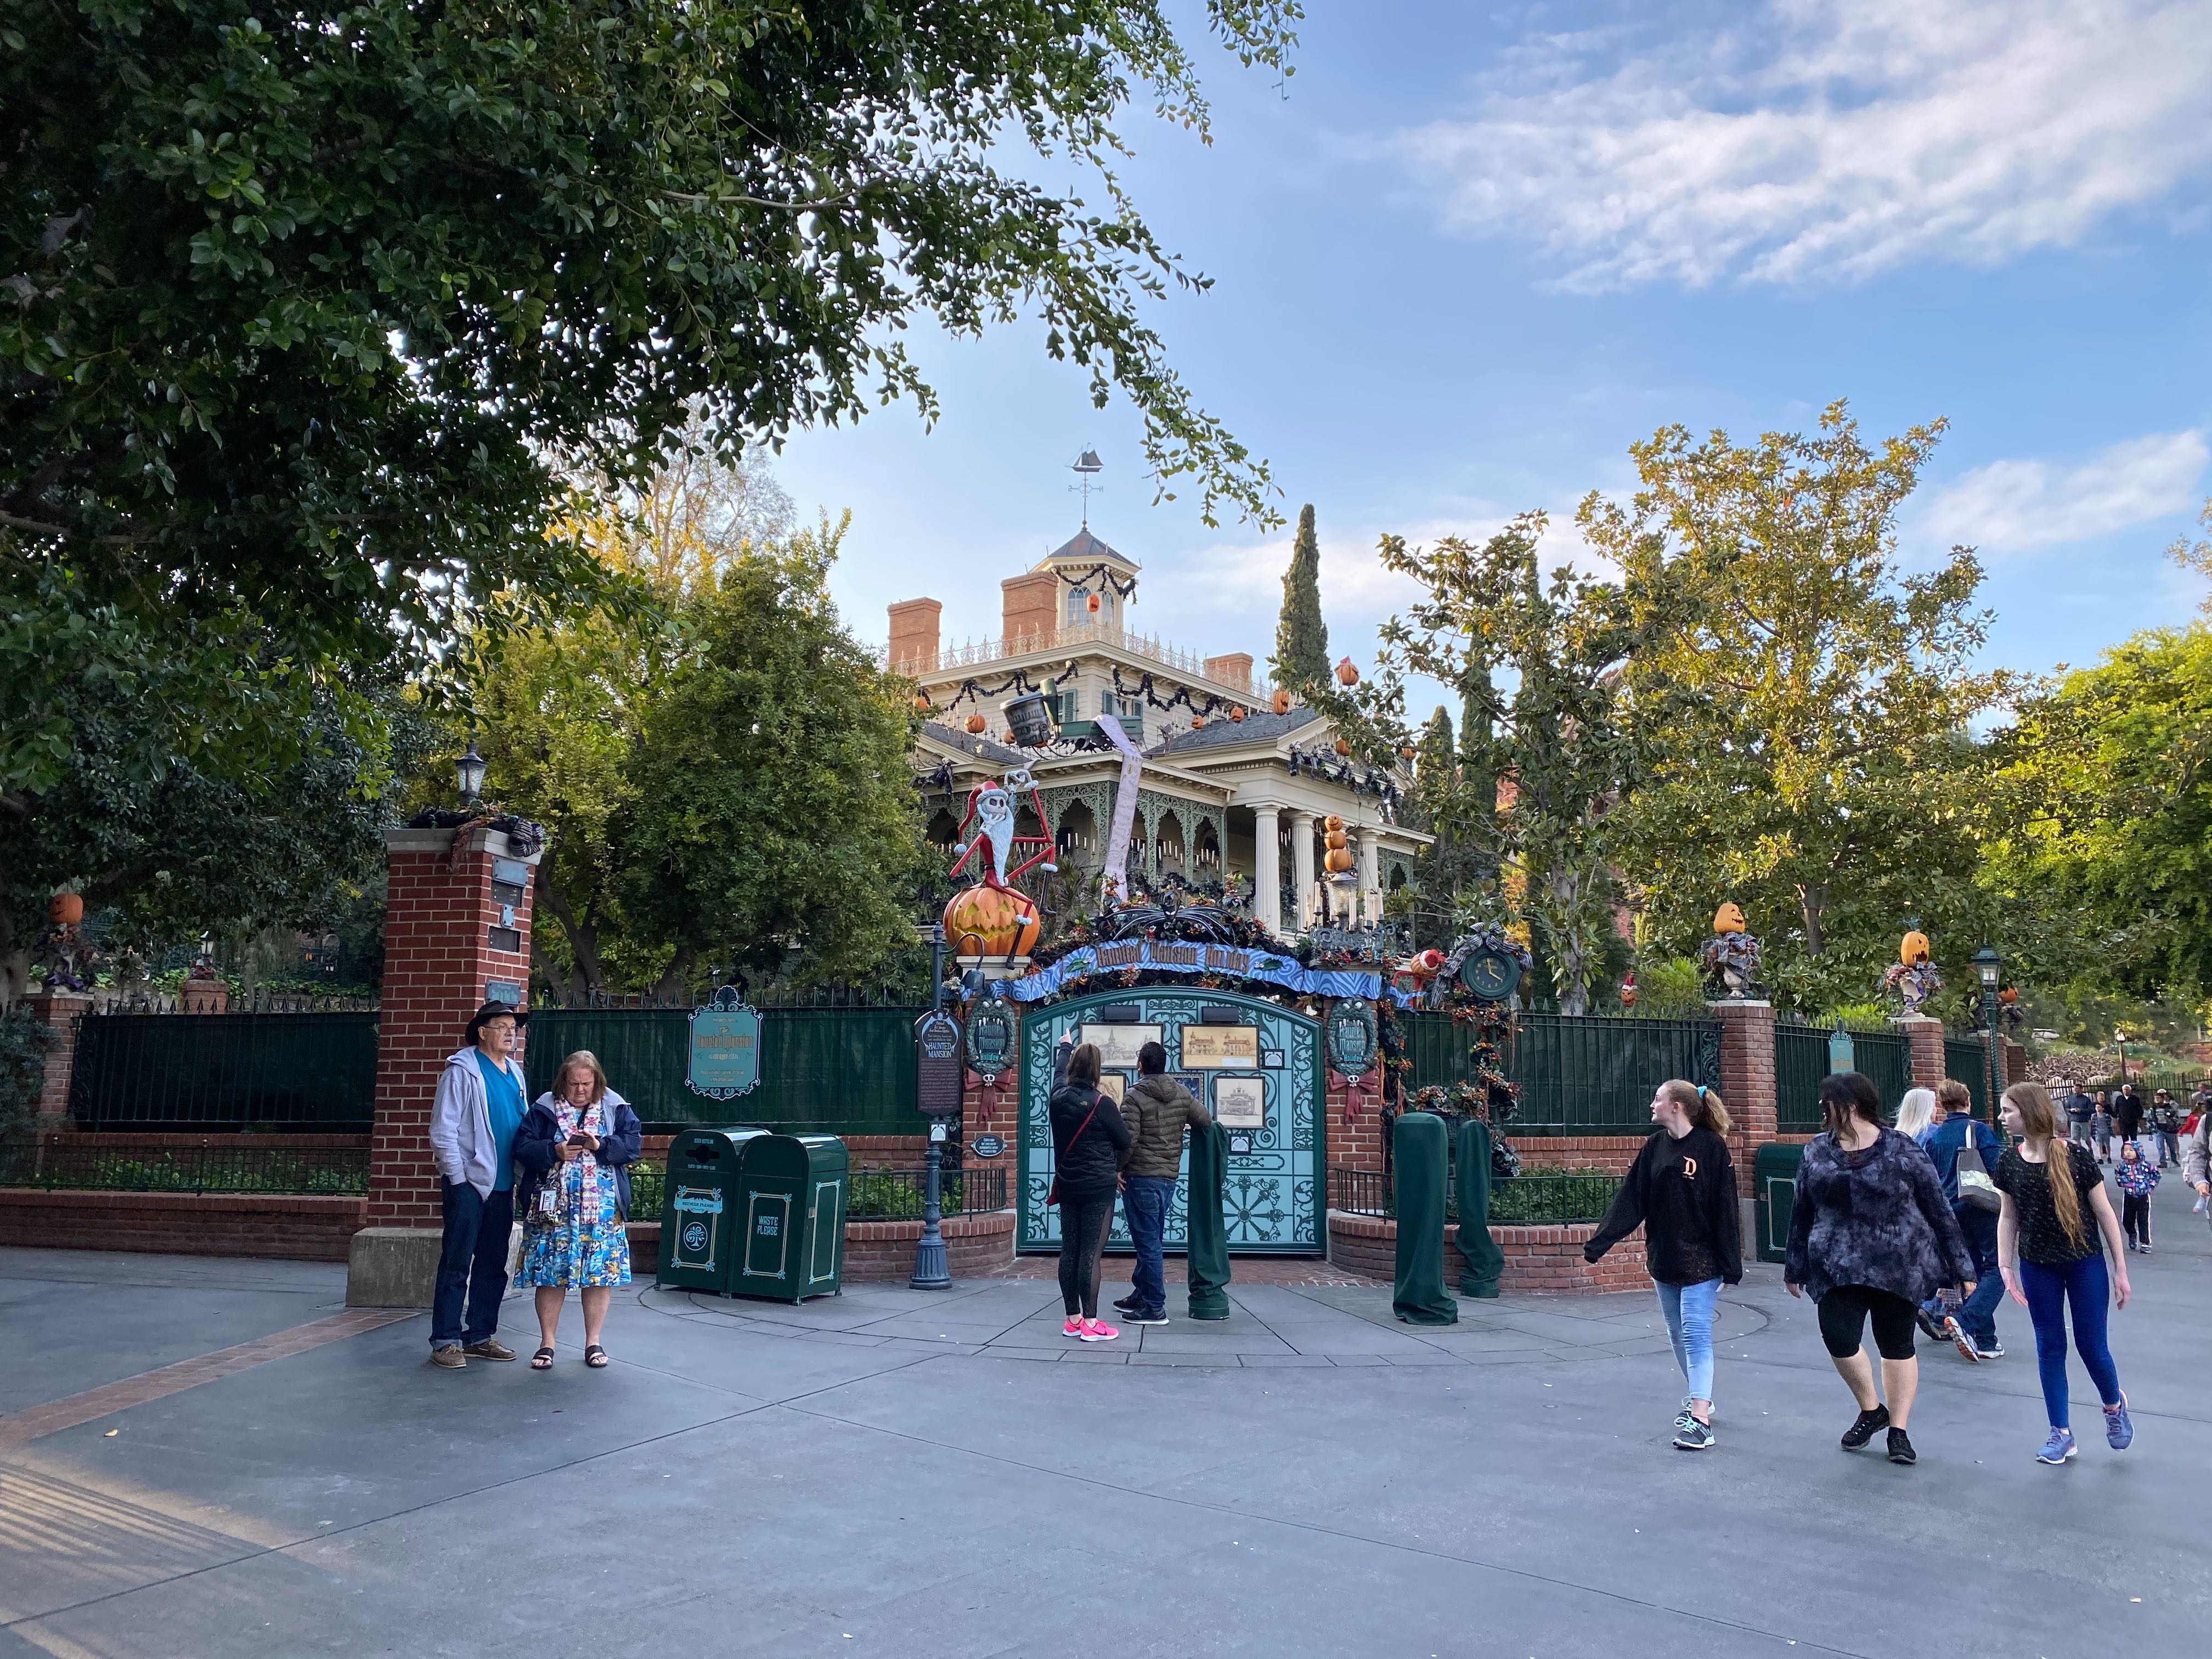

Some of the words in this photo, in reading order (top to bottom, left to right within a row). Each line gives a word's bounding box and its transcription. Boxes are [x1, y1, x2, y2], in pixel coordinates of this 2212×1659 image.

[1096, 943, 1142, 967] Haunted
[1150, 942, 1197, 966] Mansion
[979, 1024, 1005, 1036] Haunted
[1339, 1025, 1364, 1038] Haunted
[696, 1032, 723, 1048] Haunted
[725, 1032, 754, 1052] Mansion
[928, 1042, 952, 1050] HAUNTED
[979, 1036, 1005, 1049] Mansion
[1339, 1038, 1365, 1051] Mansion
[928, 1049, 952, 1058] MANSION
[980, 1053, 999, 1062] Holiday
[1344, 1054, 1363, 1063] Holiday
[1682, 1155, 1697, 1176] D
[758, 1215, 778, 1226] WASTE
[757, 1224, 778, 1236] PLEASE
